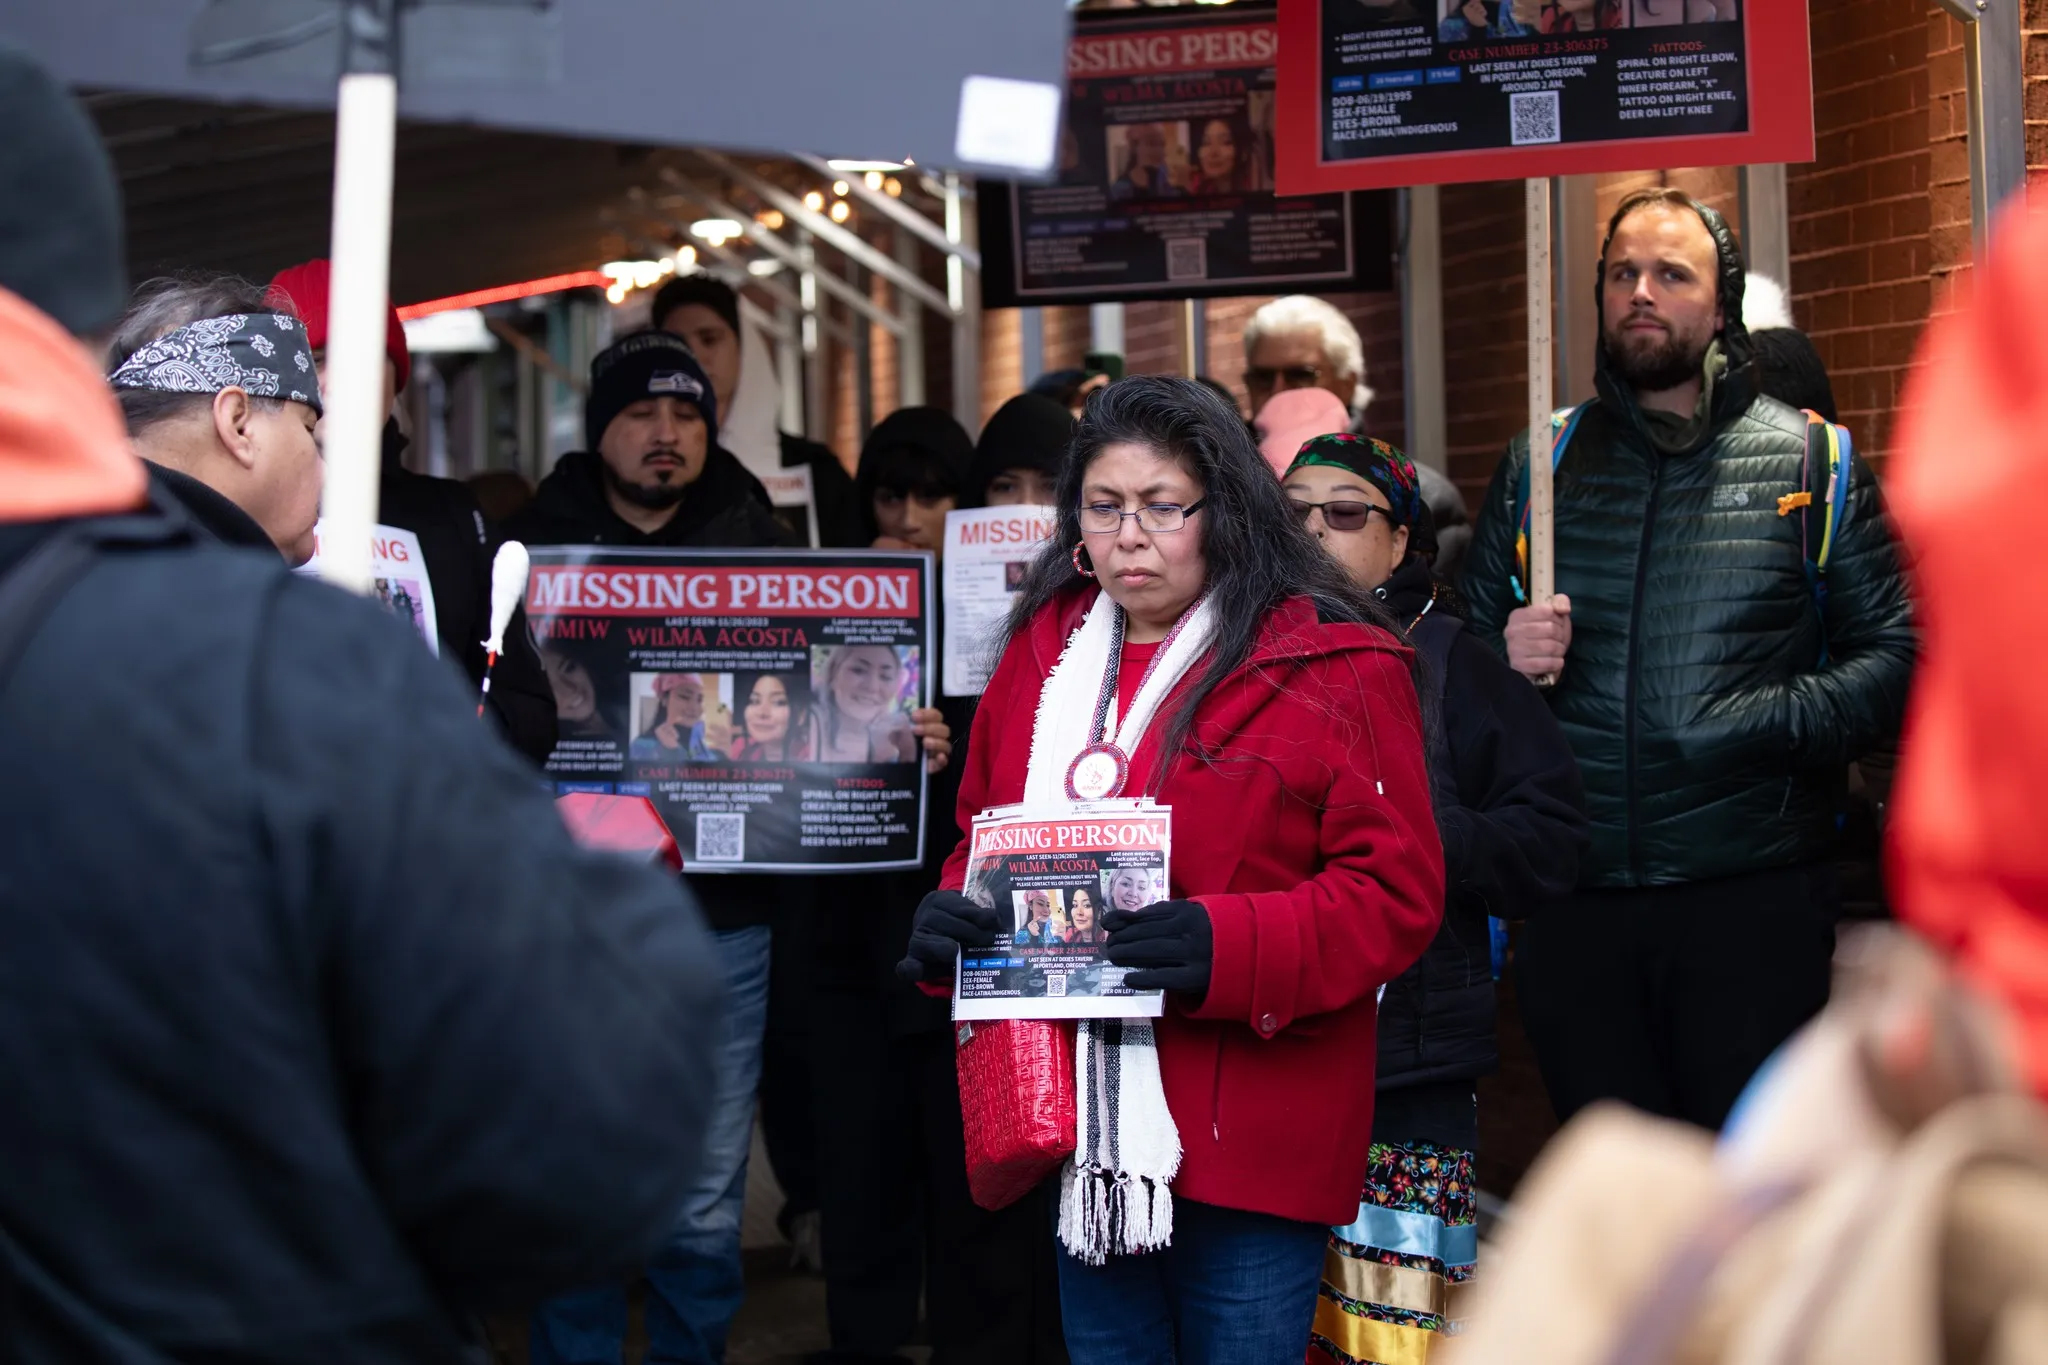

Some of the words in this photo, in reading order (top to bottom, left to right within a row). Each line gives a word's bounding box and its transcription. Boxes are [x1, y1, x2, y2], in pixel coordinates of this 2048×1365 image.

[1068, 36, 1173, 72] SSING
[1180, 28, 1278, 65] PERS
[1448, 48, 1482, 62] CASE
[1485, 43, 1540, 58] NUMBER
[1543, 38, 1608, 54] 23-306375
[1469, 63, 1490, 74] LAST
[1493, 62, 1516, 72] SEEN
[1518, 60, 1529, 70] AT
[1531, 58, 1560, 69] DIXIES
[1561, 54, 1597, 66] TAVERN
[1616, 59, 1650, 69] SPIRAL
[1652, 58, 1666, 66] ON
[1668, 54, 1698, 65] RIGHT
[1700, 52, 1738, 63] ELBOW,
[1480, 74, 1490, 83] IN
[1492, 70, 1544, 82] PORTLAND,
[1546, 68, 1587, 78] OREGON,
[1617, 70, 1667, 82] CREATURE
[1669, 68, 1684, 78] ON
[1686, 66, 1708, 76] LEFT
[1501, 82, 1540, 92] AROUND
[1542, 81, 1547, 90] 2
[1548, 80, 1566, 88] AM.
[1618, 84, 1648, 94] INNER
[1650, 80, 1699, 92] FOREARM,
[1332, 91, 1412, 107] DOB-06/19/1995
[1618, 96, 1657, 107] TATTOO
[1659, 95, 1673, 104] ON
[1674, 92, 1705, 103] RIGHT
[1706, 90, 1736, 101] KNEE,
[1332, 104, 1396, 118] SEX-FEMALE
[1619, 109, 1644, 120] DEER
[1646, 108, 1660, 118] ON
[1662, 106, 1686, 116] LEFT
[1687, 104, 1713, 114] KNEE
[1332, 115, 1401, 130] EYES-BROWN
[1332, 122, 1458, 140] RACE-LATINA/INDIGENOUS
[960, 519, 1051, 545] MISSIN
[532, 572, 718, 608] MISSING
[728, 573, 910, 609] PERSON
[627, 628, 707, 647] WILMA
[715, 628, 808, 647] ACOSTA
[978, 827, 1052, 853] MISSING
[1057, 824, 1159, 848] PERSON
[1008, 861, 1048, 873] WILMA
[1052, 860, 1098, 872] ACOSTA
[1037, 947, 1064, 955] NUMBER
